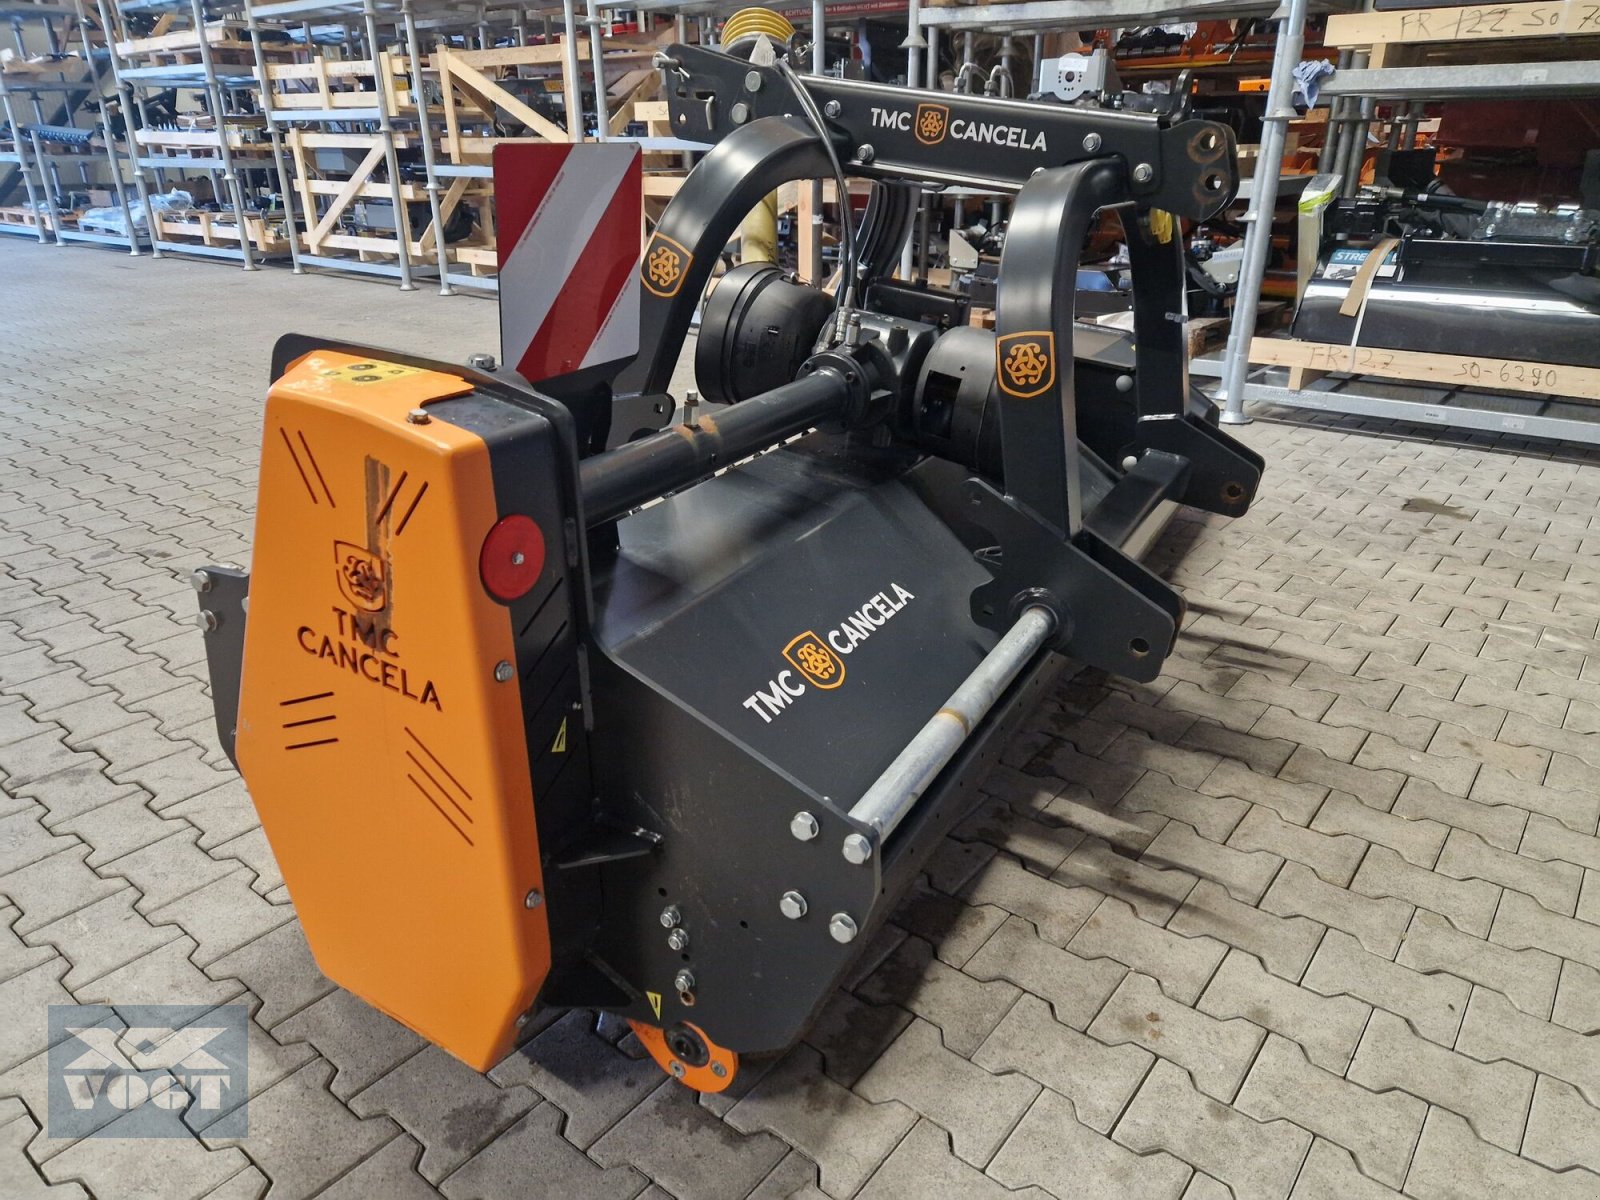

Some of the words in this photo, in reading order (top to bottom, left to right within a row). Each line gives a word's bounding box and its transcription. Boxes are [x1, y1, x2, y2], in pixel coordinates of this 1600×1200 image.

[871, 107, 912, 131] TMC
[950, 119, 1047, 151] CANCELA
[332, 606, 400, 658] TMC
[742, 670, 806, 723] TMC
[828, 582, 915, 655] CANCELA
[297, 625, 442, 713] CANCELA
